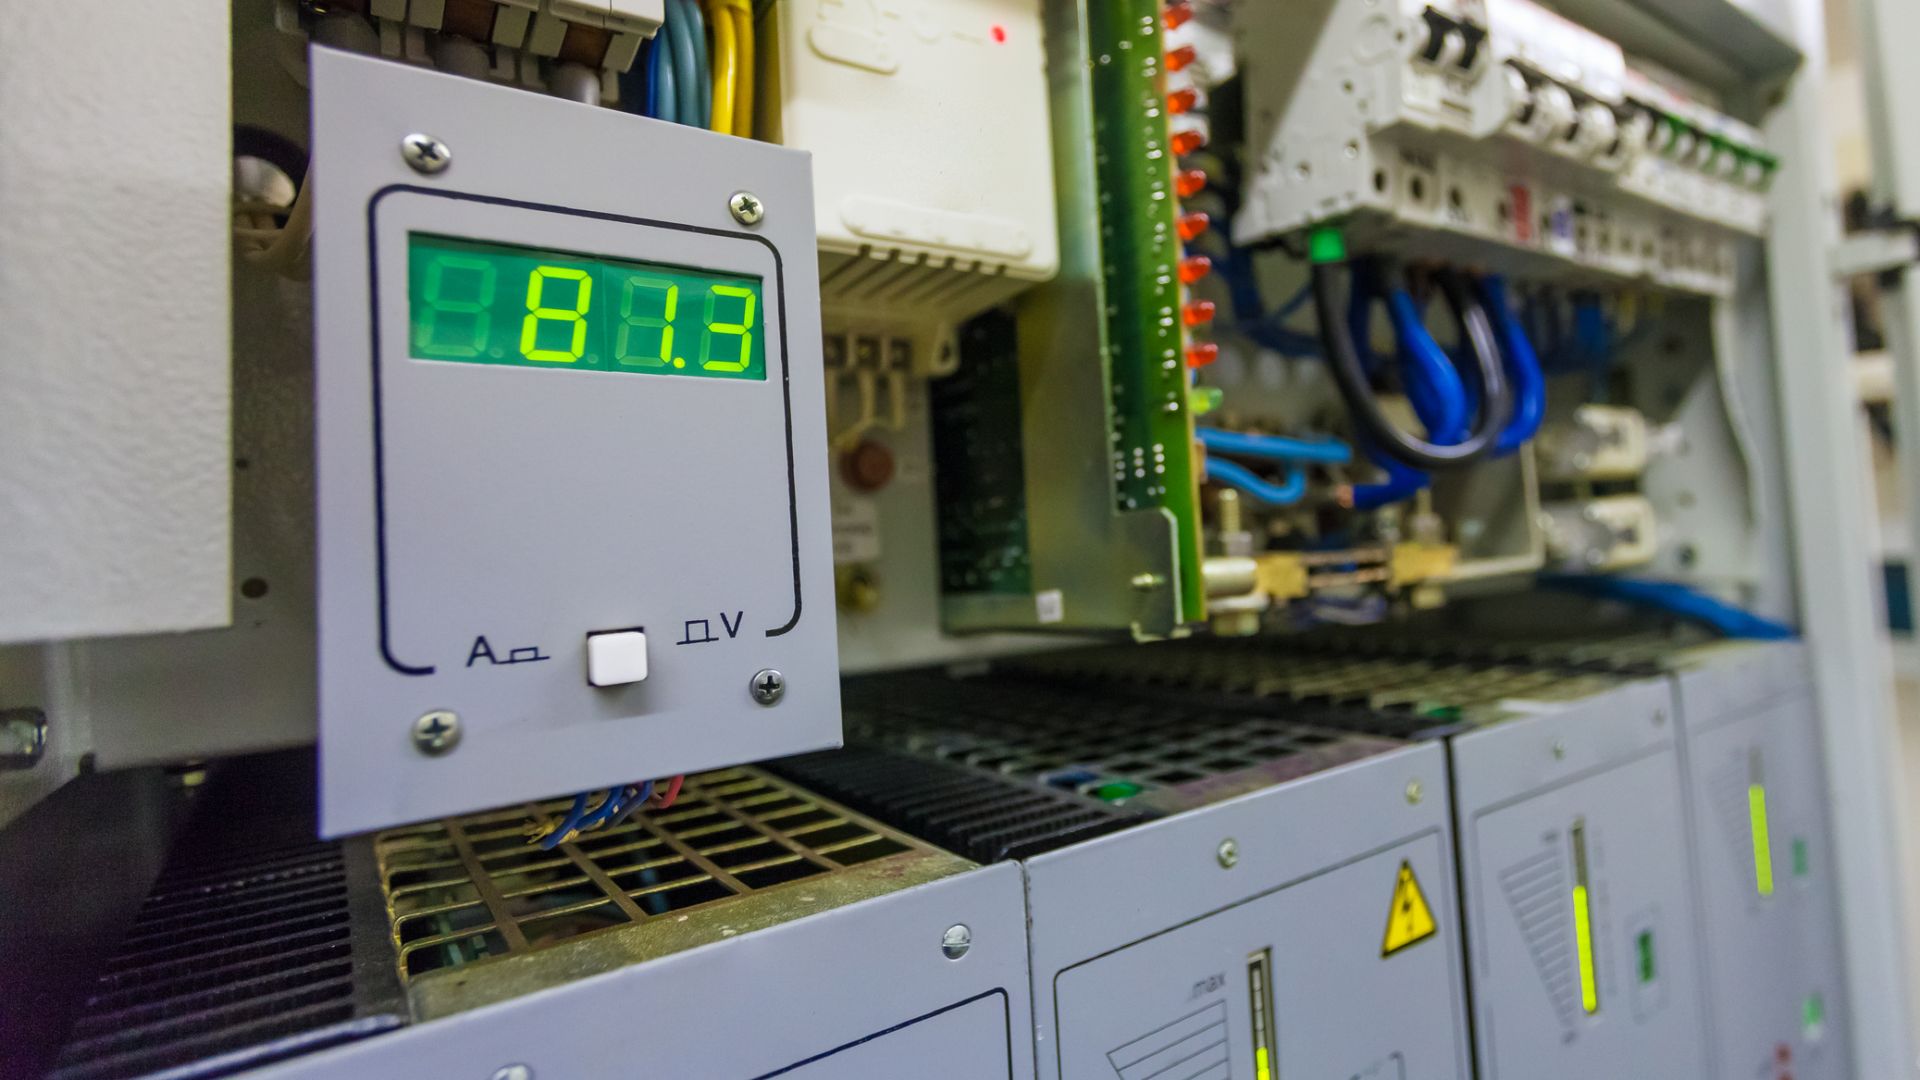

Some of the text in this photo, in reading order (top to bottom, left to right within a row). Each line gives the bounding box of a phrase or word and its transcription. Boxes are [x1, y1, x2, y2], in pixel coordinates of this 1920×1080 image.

[519, 265, 756, 373] 81.3
[720, 611, 744, 638] V
[466, 635, 497, 667] A
